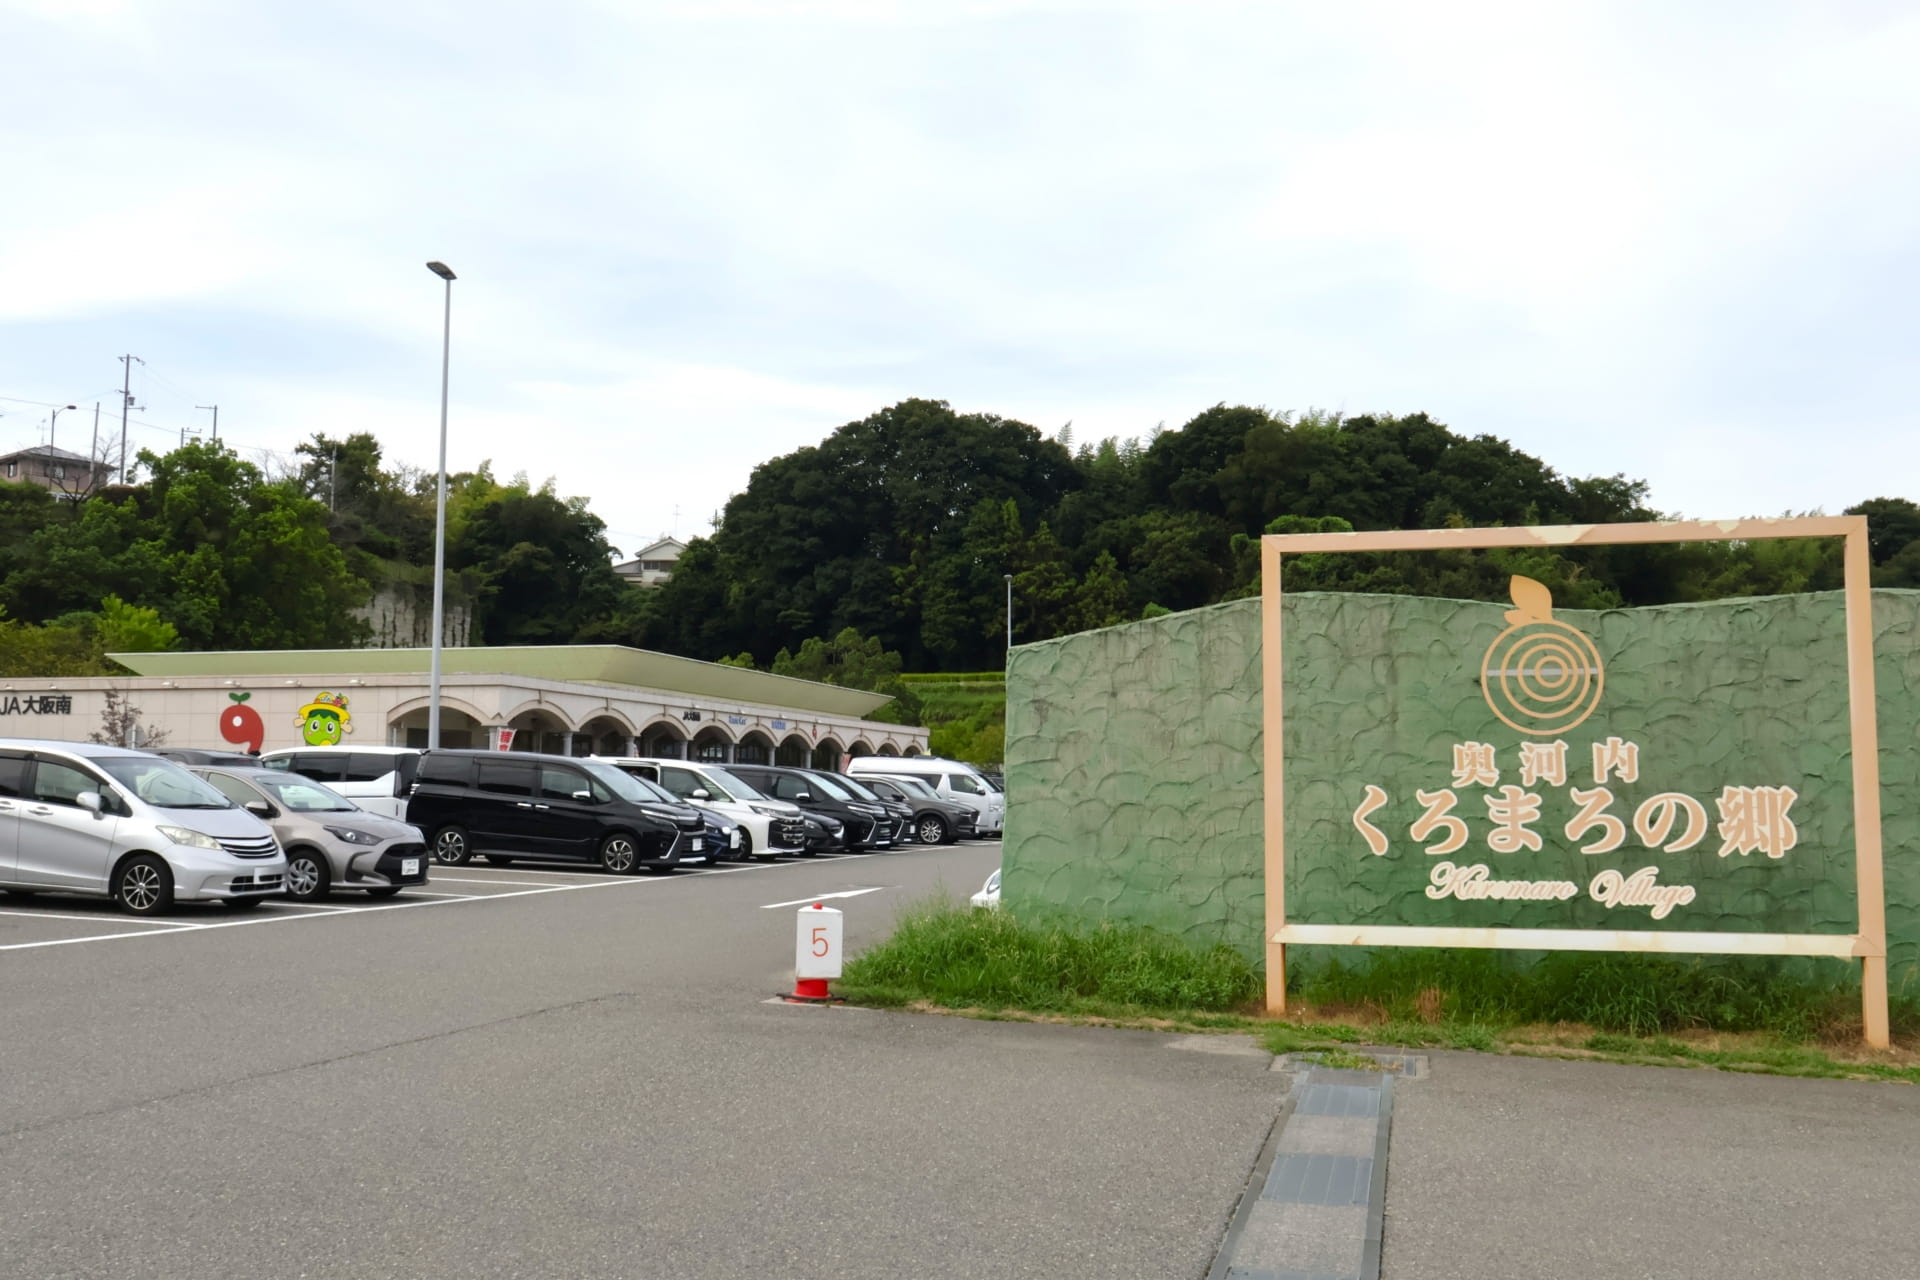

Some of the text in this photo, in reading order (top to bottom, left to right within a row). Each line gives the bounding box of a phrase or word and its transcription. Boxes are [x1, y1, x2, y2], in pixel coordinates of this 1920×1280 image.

[0, 695, 72, 715] JA大阪南
[1452, 737, 1639, 788] 奥河内
[1353, 785, 1798, 859] くろまろの郷
[1425, 861, 1696, 920] Kurmaro Village
[812, 927, 829, 957] 5
